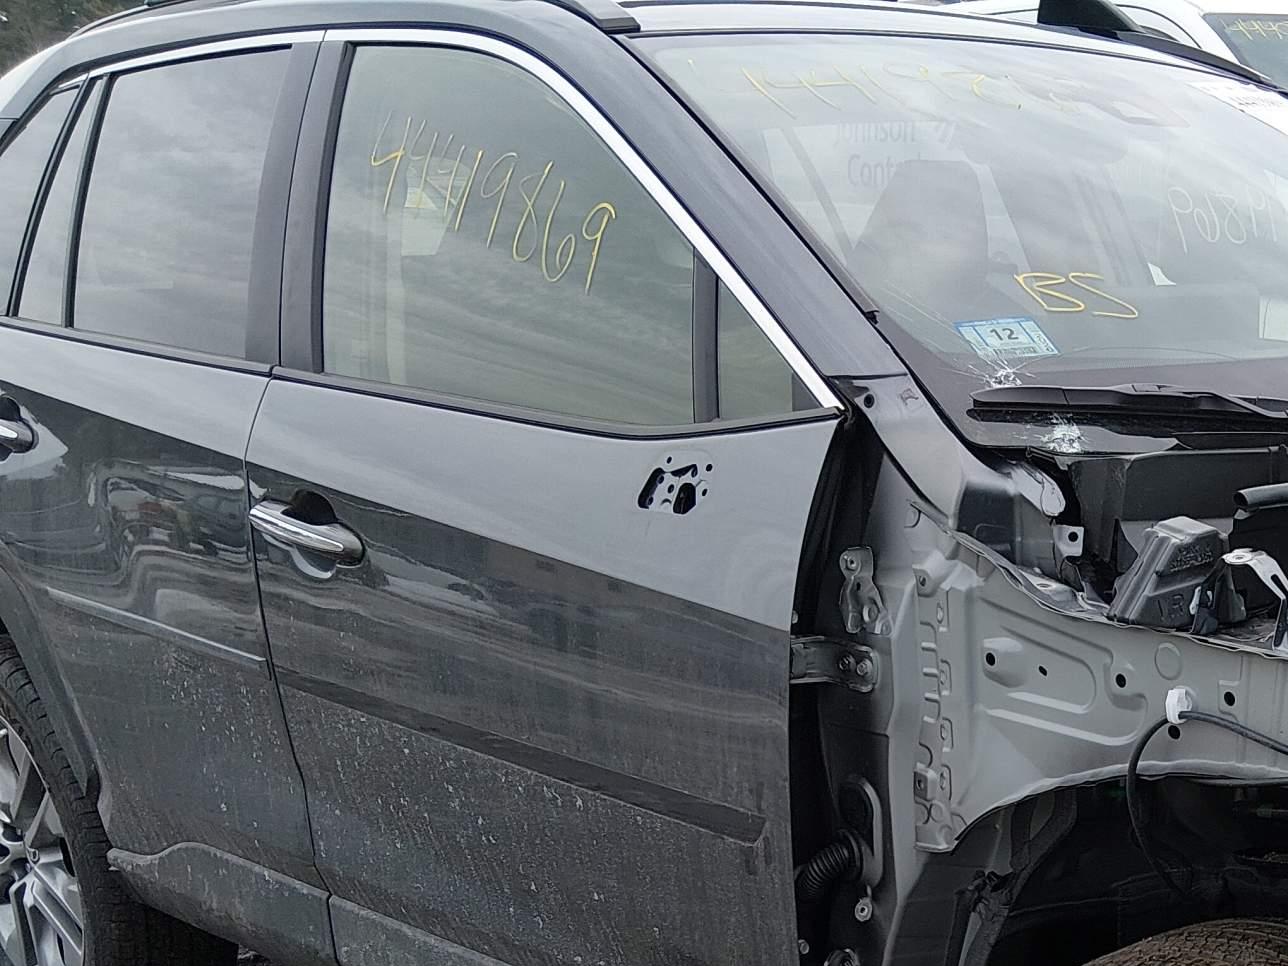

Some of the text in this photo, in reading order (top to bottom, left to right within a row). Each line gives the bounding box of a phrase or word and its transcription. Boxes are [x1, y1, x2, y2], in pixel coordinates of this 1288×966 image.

[370, 109, 617, 296] 44419869
[1013, 272, 1138, 319] BS
[990, 327, 1019, 341] 12
